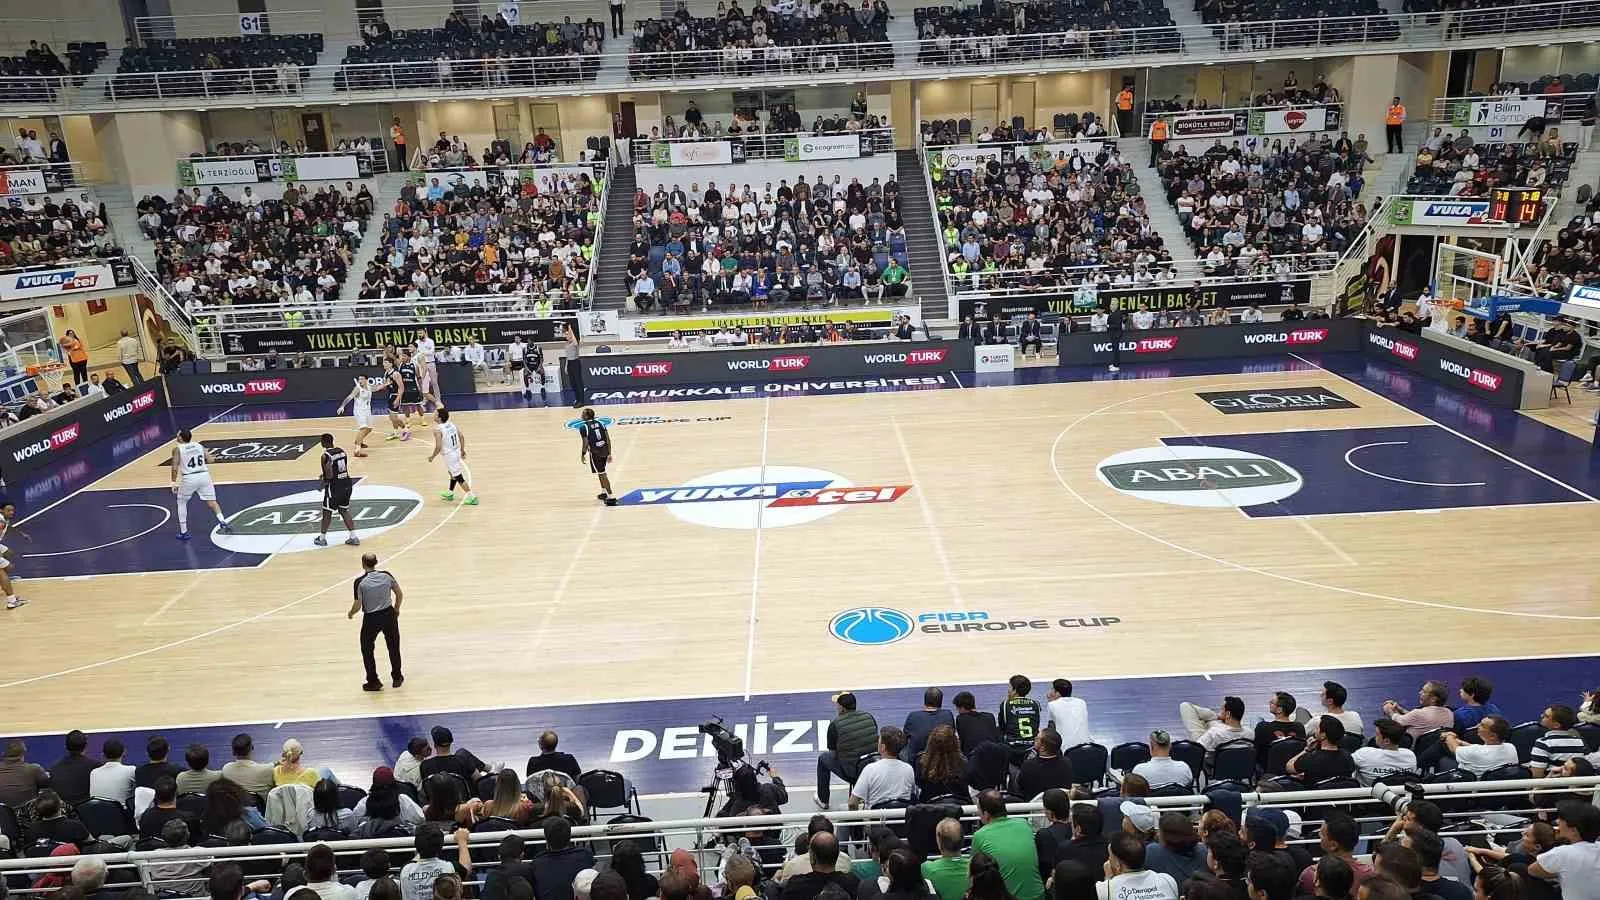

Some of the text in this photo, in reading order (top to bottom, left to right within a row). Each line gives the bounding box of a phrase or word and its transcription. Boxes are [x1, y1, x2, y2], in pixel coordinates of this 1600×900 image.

[241, 17, 258, 30] G1
[1495, 103, 1520, 113] Bilim
[1490, 128, 1502, 137] D1
[815, 144, 845, 153] ecogreen
[1432, 206, 1472, 215] YUKA
[1495, 204, 1536, 220] 14 14
[1111, 292, 1162, 310] ENİZLİ
[1168, 290, 1217, 307] BASET
[306, 331, 370, 349] YUKATEL
[375, 328, 428, 346] DENİZ
[435, 328, 487, 343] BASKET
[1244, 330, 1323, 344] WORLD TURK
[1141, 339, 1174, 350] TURK
[1369, 333, 1415, 358] WORLD TURK
[727, 357, 806, 370] WORLD TURK
[864, 351, 942, 364] WORLD TURK
[589, 364, 668, 376] WORLD TURK
[1440, 359, 1497, 389] WORLD TURK
[201, 381, 282, 394] WORLD TURK
[590, 375, 945, 401] PAMUKKALE ÜNİVERSİTESİ
[1210, 394, 1344, 407] GLORIA
[103, 393, 154, 423] WORLD TURK
[12, 428, 78, 462] WORLD TURK
[450, 434, 459, 446] 11
[187, 455, 204, 469] 46
[1129, 464, 1273, 483] ABALI
[638, 484, 896, 502] YUKA tel
[918, 611, 990, 623] FIBA
[920, 616, 1121, 634] EUROPE CUP
[1018, 717, 1033, 738] 5
